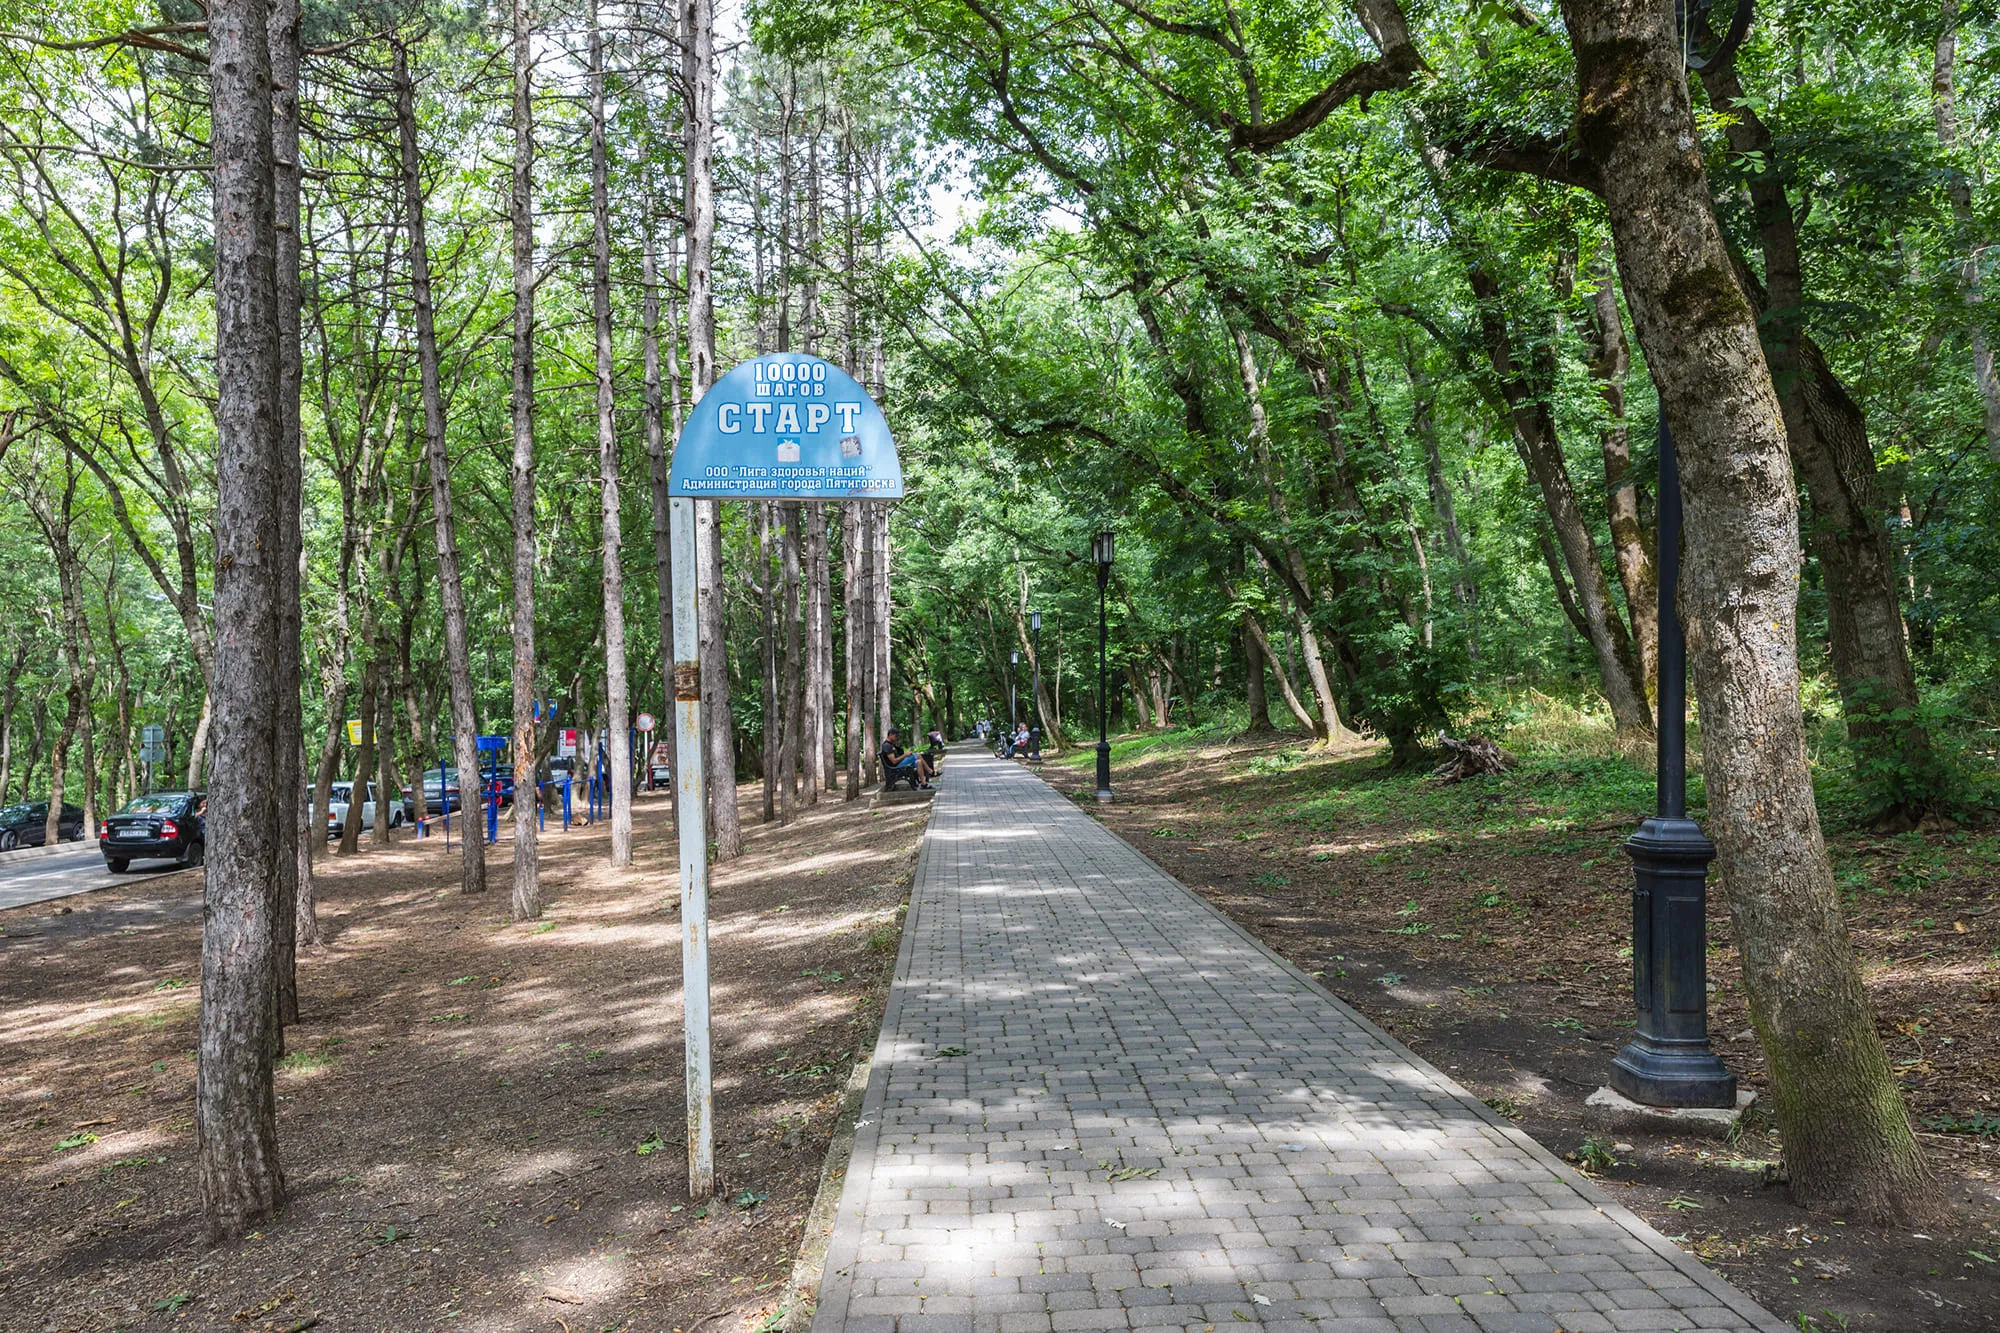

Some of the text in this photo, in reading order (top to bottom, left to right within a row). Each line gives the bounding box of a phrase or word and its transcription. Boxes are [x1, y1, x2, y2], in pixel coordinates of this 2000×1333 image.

[754, 362, 826, 382] 10000
[755, 383, 825, 397] ШАГОВ
[718, 402, 861, 434] СТАРТ
[771, 467, 826, 479] здоровья
[682, 478, 896, 491] Администрация города Пятигорска
